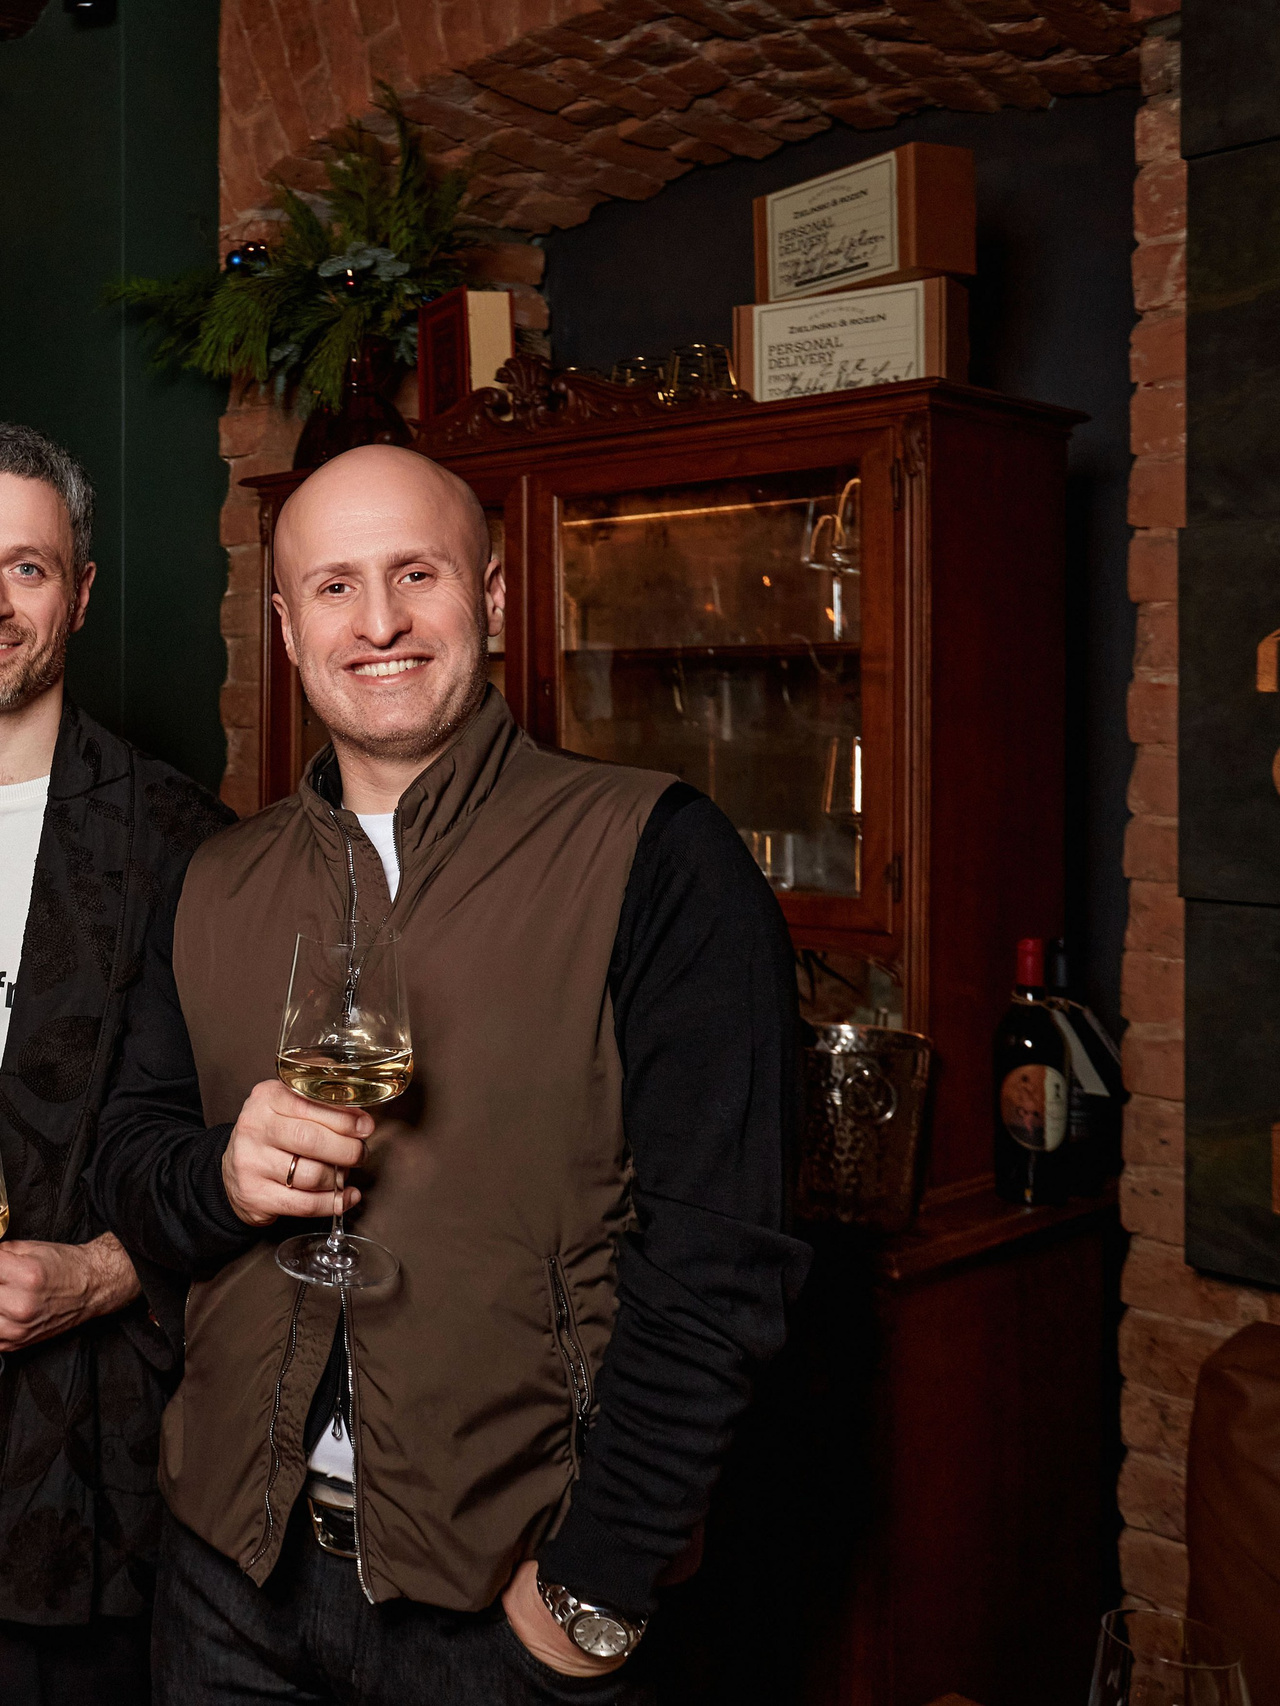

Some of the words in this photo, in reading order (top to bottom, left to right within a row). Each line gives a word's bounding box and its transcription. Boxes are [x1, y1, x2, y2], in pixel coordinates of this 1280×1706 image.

[778, 216, 835, 243] PERSONAL
[778, 231, 829, 257] DELIVERY
[768, 336, 844, 356] PERSONAL
[768, 351, 835, 370] DELIVERY
